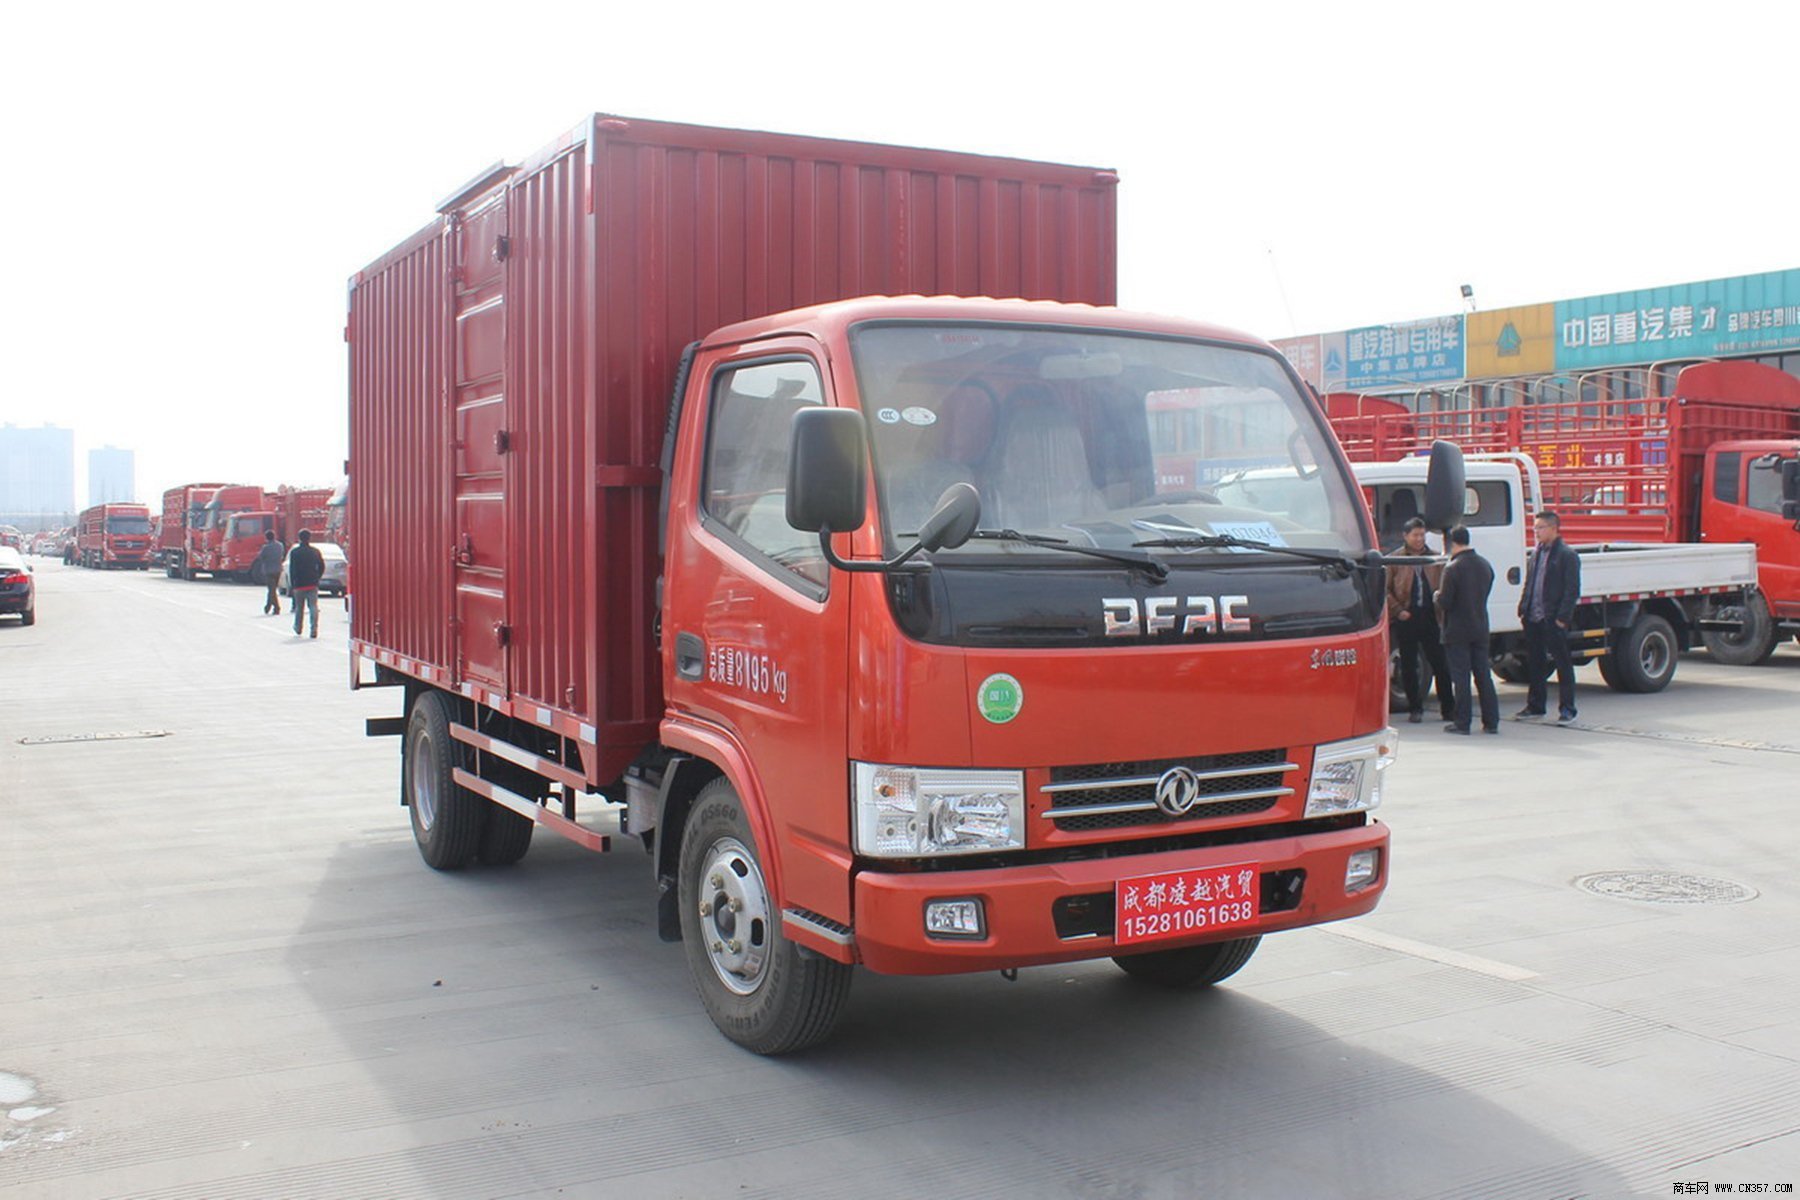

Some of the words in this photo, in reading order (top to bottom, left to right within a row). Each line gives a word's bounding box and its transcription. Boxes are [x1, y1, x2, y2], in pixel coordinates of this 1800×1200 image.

[1102, 595, 1250, 636] DFAC
[1124, 870, 1254, 913] 成都凌越汽贸
[1124, 901, 1252, 938] 15281061638
